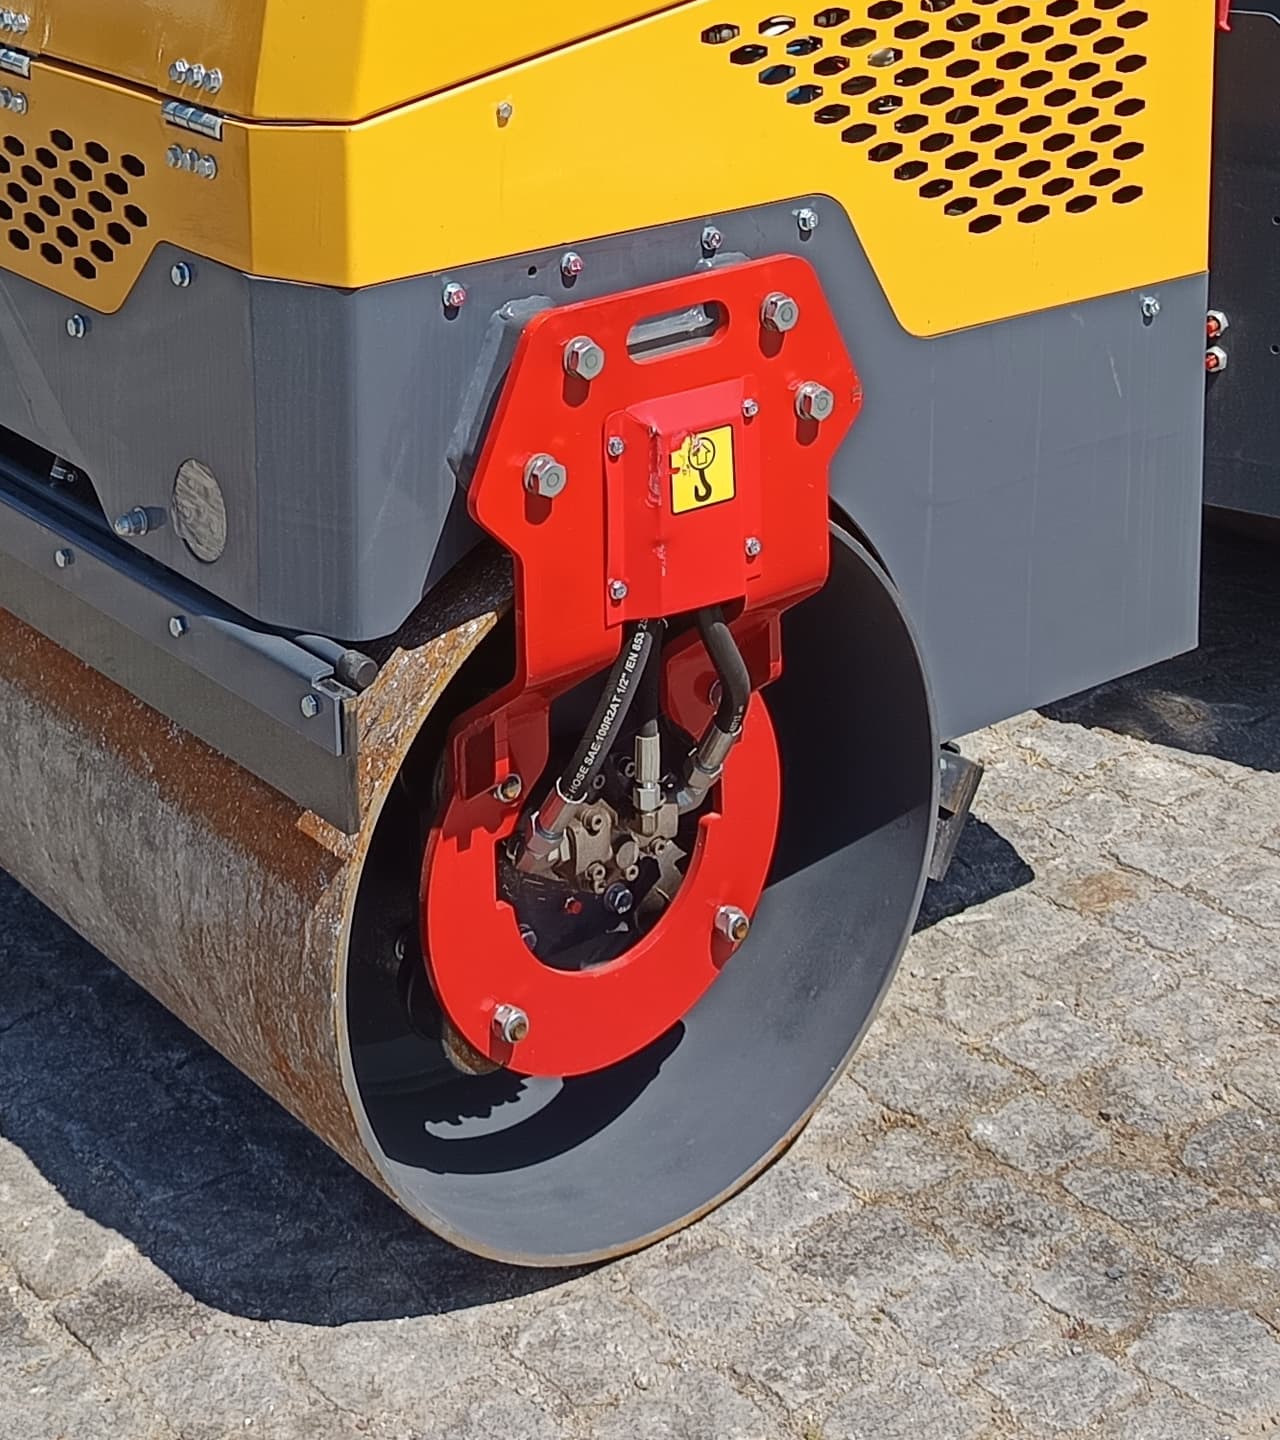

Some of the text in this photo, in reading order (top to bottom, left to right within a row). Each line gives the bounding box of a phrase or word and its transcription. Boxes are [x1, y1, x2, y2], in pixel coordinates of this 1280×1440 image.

[568, 764, 590, 794] HOSE
[583, 742, 601, 766] SAE
[595, 694, 622, 741] 100R2AT
[631, 632, 645, 651] 853
